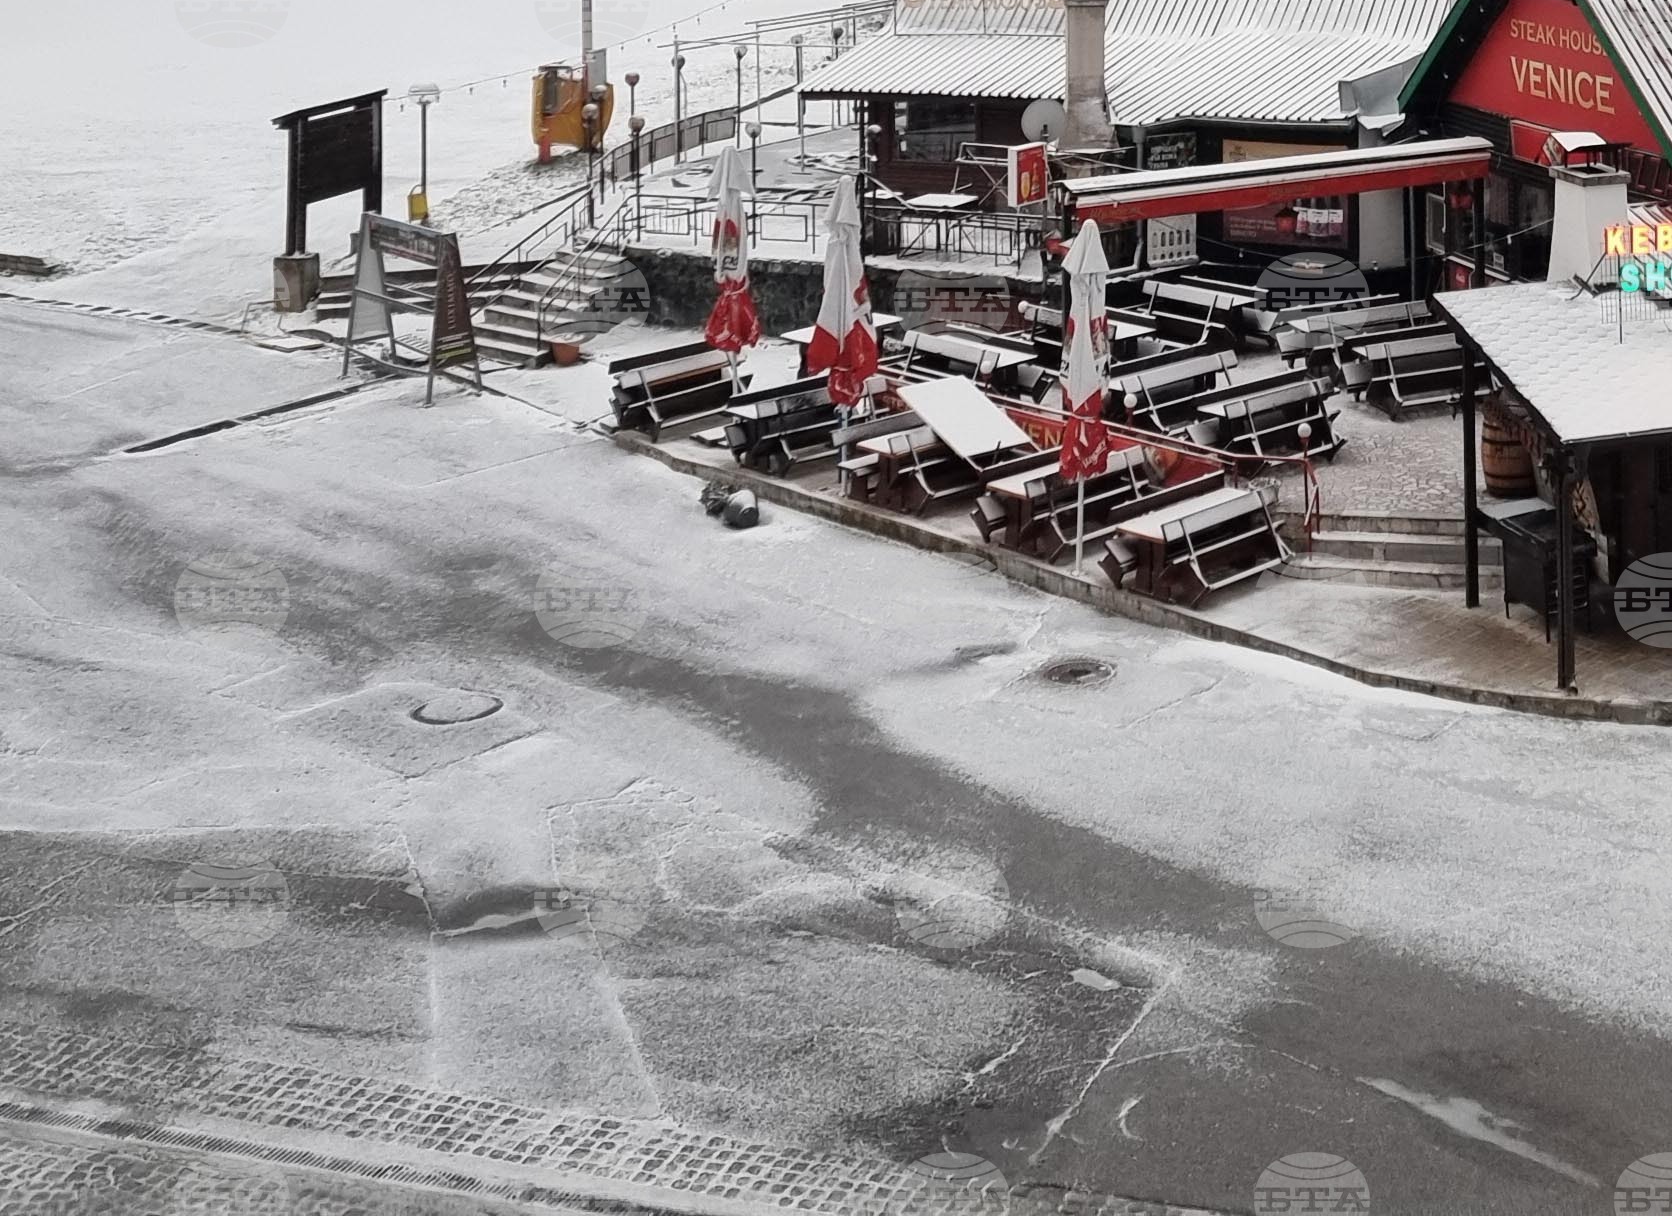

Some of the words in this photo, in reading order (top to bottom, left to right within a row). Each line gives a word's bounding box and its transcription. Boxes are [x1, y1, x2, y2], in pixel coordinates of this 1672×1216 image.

[1510, 18, 1556, 47] STEAK
[1559, 27, 1608, 57] HOUS
[1510, 55, 1616, 116] VENICE
